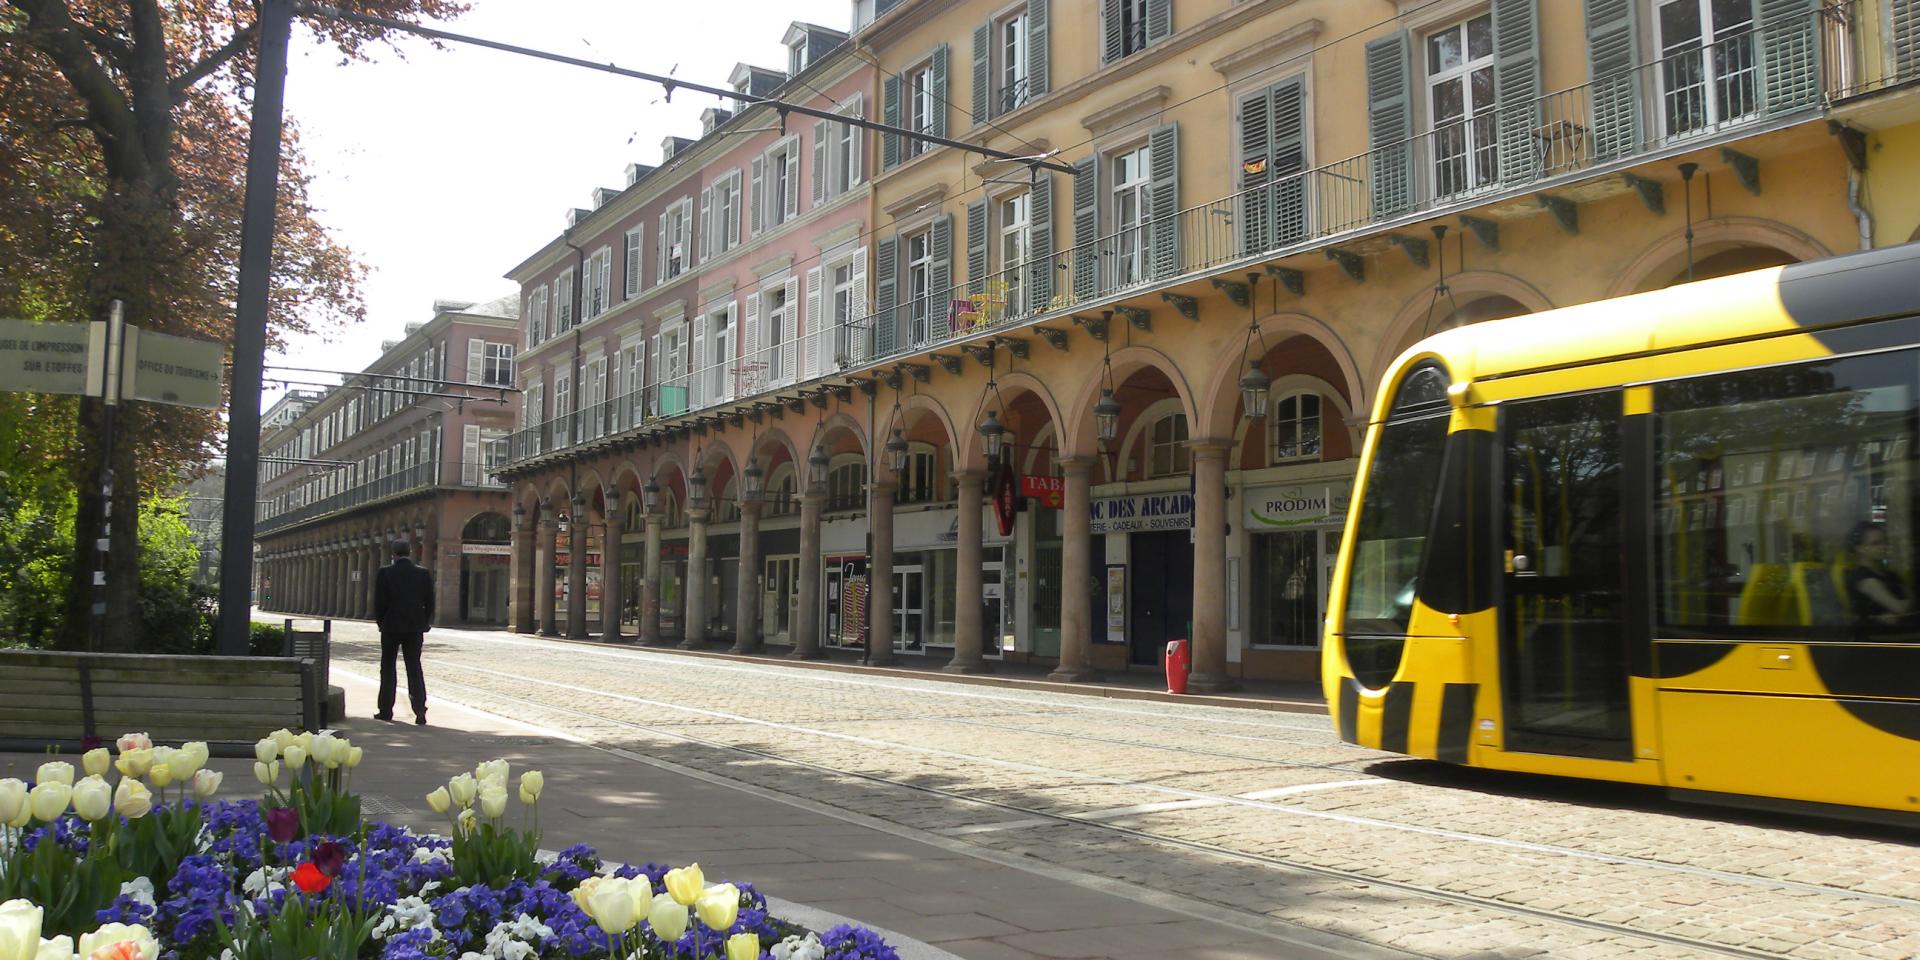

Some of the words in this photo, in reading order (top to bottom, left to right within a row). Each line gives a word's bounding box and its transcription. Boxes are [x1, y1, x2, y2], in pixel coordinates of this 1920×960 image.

[23, 360, 41, 372] SUR
[46, 361, 83, 374] ETOFFES
[138, 359, 163, 373] OFFICE
[164, 363, 174, 375] DU
[175, 366, 209, 380] TOURISME
[1026, 476, 1063, 491] TAB
[1108, 497, 1135, 519] DES
[1141, 494, 1191, 516] ARCAD
[1266, 498, 1326, 513] PRODIM
[1112, 519, 1143, 531] CADEAUX
[1150, 516, 1190, 529] SOUVENIRS
